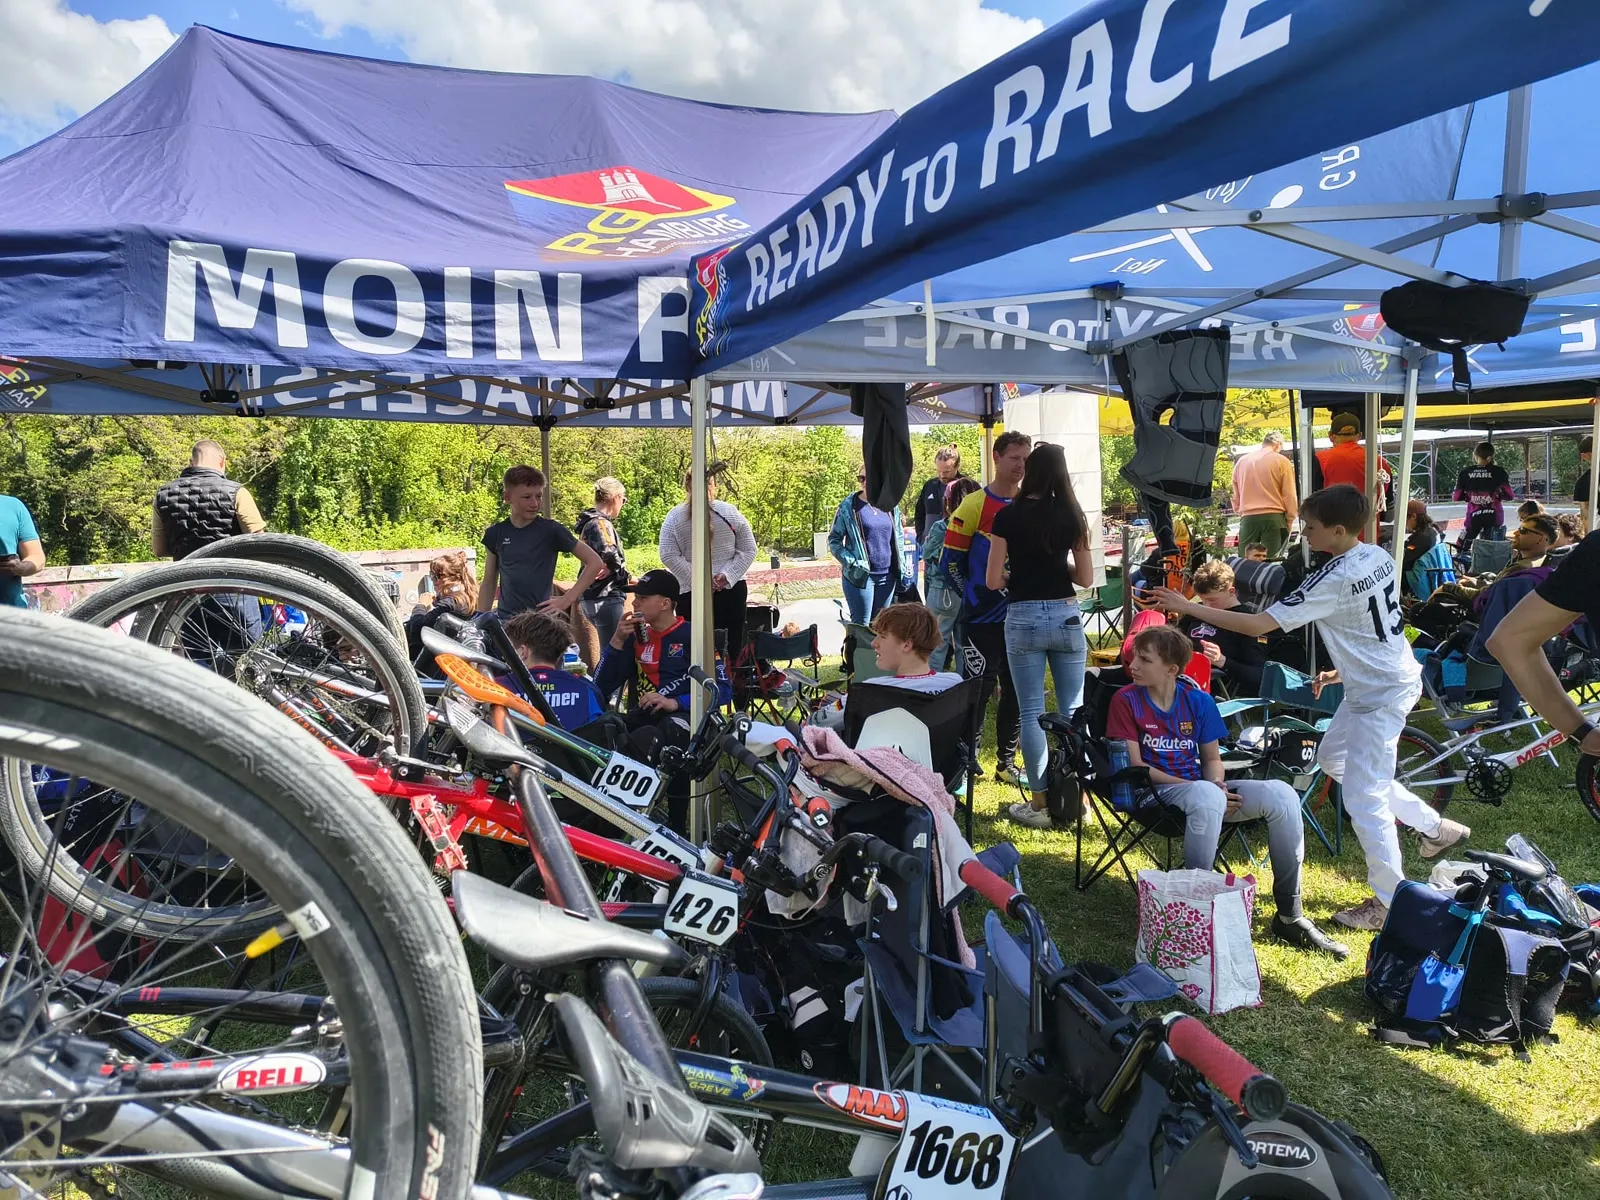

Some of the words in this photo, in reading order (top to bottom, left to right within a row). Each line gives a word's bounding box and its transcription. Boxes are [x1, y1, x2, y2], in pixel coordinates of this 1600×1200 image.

[745, 150, 894, 312] READY
[901, 140, 958, 226] TO
[979, 0, 1293, 190] RACE
[544, 209, 650, 256] RG
[606, 213, 752, 258] HAMBURG
[163, 240, 584, 362] MOIN
[1350, 575, 1377, 597] ARDA
[1366, 579, 1405, 643] 15
[1142, 733, 1194, 750] Rakuten
[1516, 731, 1566, 767] MEYB
[605, 764, 654, 798] 800
[668, 893, 736, 936] 426
[235, 1066, 308, 1090] BELL
[688, 1081, 733, 1097] GREVE
[904, 1119, 1005, 1190] 1668
